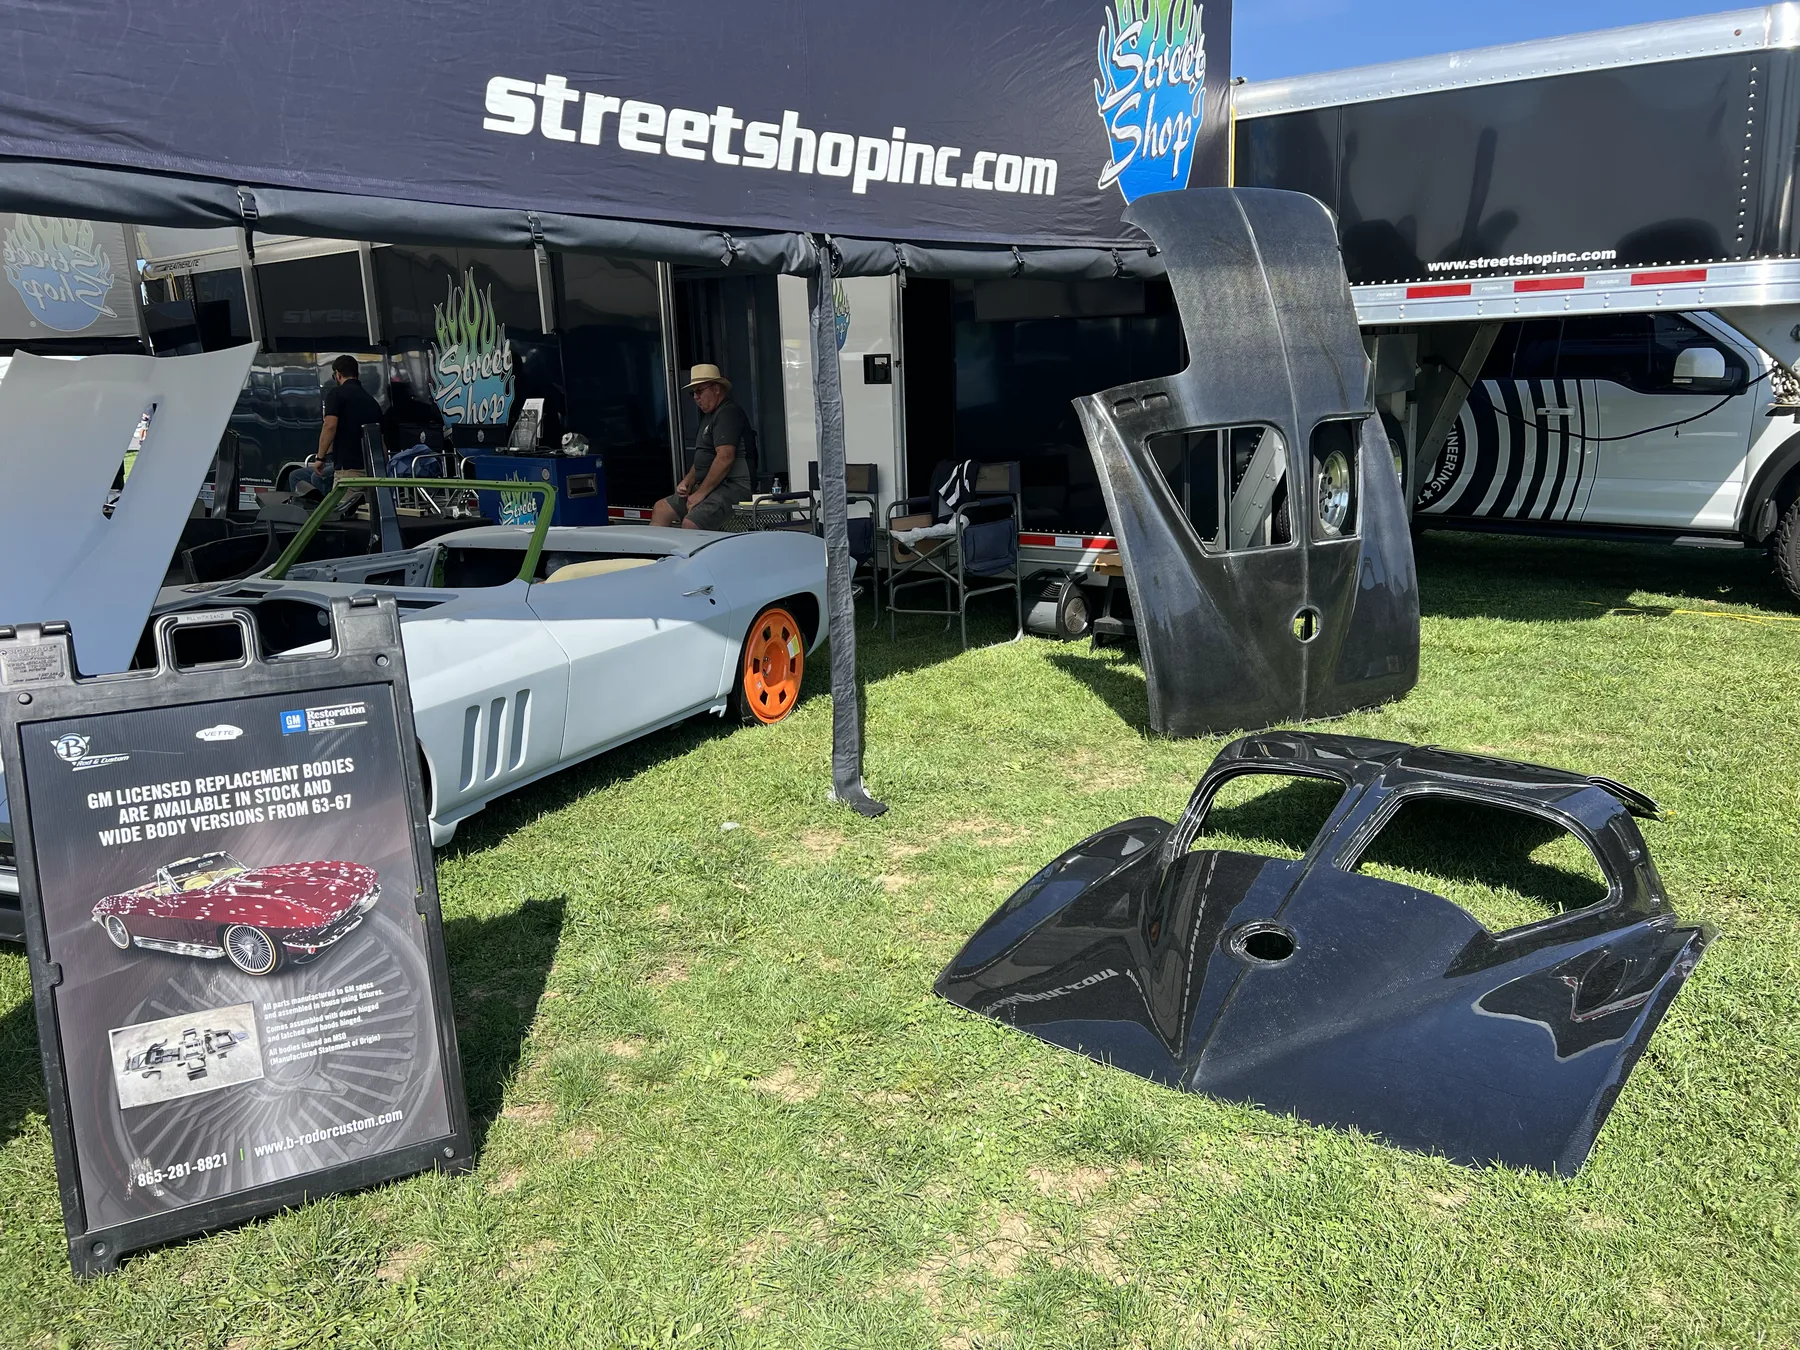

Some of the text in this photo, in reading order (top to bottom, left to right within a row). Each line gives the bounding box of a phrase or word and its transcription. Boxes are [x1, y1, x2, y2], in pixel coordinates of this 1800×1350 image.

[1102, 20, 1206, 111] Street
[483, 74, 1058, 196] streetshopinc.com
[1100, 92, 1192, 184] Shop
[1427, 249, 1617, 272] www.streetshopinc.com
[435, 339, 513, 401] Street
[443, 385, 505, 424] Shop
[502, 497, 537, 526] Street
[285, 715, 301, 726] GM
[306, 705, 366, 720] Restoration
[307, 717, 336, 729] Parts
[203, 729, 235, 737] VETTE
[76, 759, 93, 767] Rod
[101, 755, 130, 764] Custom
[87, 757, 355, 810] GM LICENSED REPLACEMENT BODIES
[118, 779, 332, 825] ARE AVAILABLE IN STOCK AND
[99, 793, 352, 847] WIDE BODY VERSIONS FROM 63-67
[263, 981, 374, 1012] All parts manufactured to GM specs
[264, 988, 385, 1020] and assembled in house using fixtures.
[266, 1002, 379, 1034] Comes assembled with doors hinged
[267, 1015, 363, 1043] and latched and hoods hinged.
[269, 1032, 347, 1057] All bodies issued an MSO
[269, 1033, 381, 1067] (Manufactured Statement of Origin)
[138, 1109, 403, 1187] 865-281-8821 www.b-rodorcustom.com
